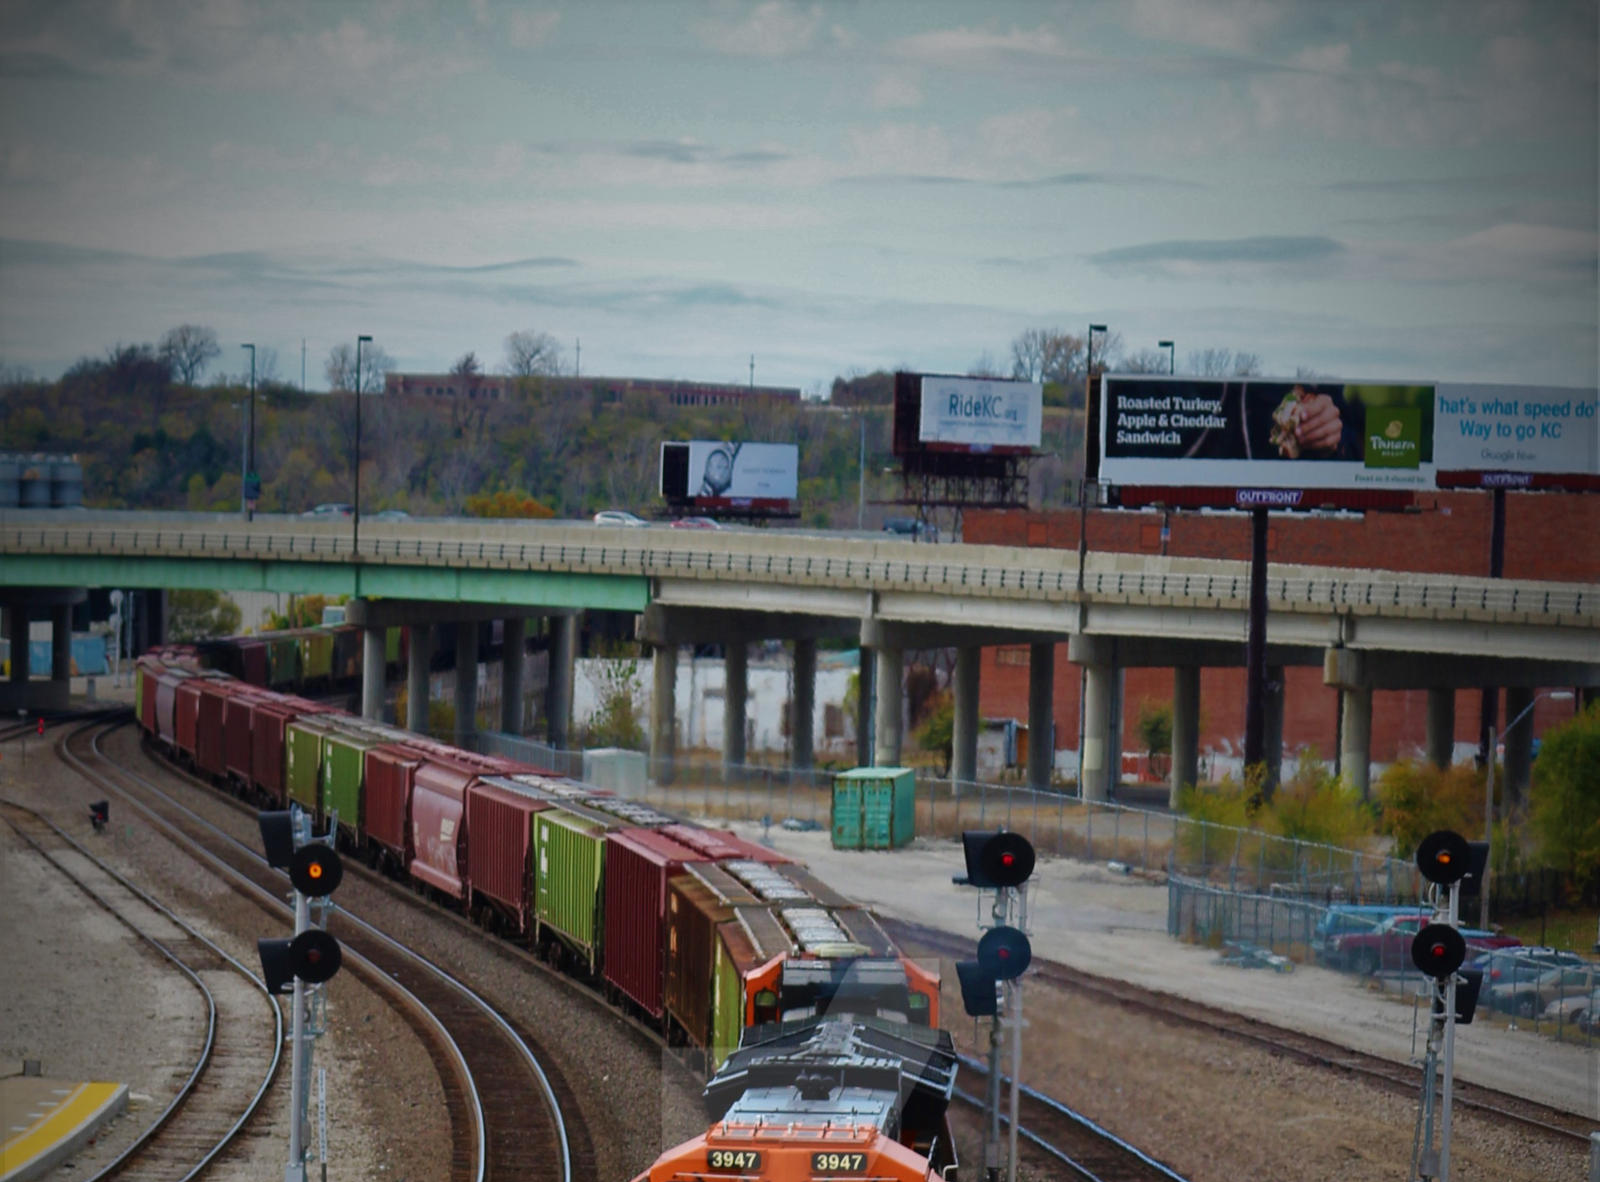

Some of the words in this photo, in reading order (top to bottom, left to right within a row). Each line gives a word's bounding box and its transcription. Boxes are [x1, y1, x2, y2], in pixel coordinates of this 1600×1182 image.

[1117, 395, 1171, 410] Roasted
[1172, 396, 1222, 414] Turkey,
[1438, 395, 1477, 415] hat's
[1481, 397, 1519, 416] what
[1524, 400, 1571, 420] speed
[1117, 413, 1156, 429] Apple
[1158, 413, 1169, 427] &
[1170, 413, 1228, 428] Cheddar
[1116, 430, 1182, 444] Sandwich
[1460, 419, 1492, 441] Way
[1496, 421, 1512, 437] to
[1515, 424, 1536, 442] go
[1540, 420, 1562, 438] KC
[1239, 490, 1300, 504] OUTFRONT
[712, 1151, 757, 1169] 3947
[816, 1153, 863, 1171] 3947
